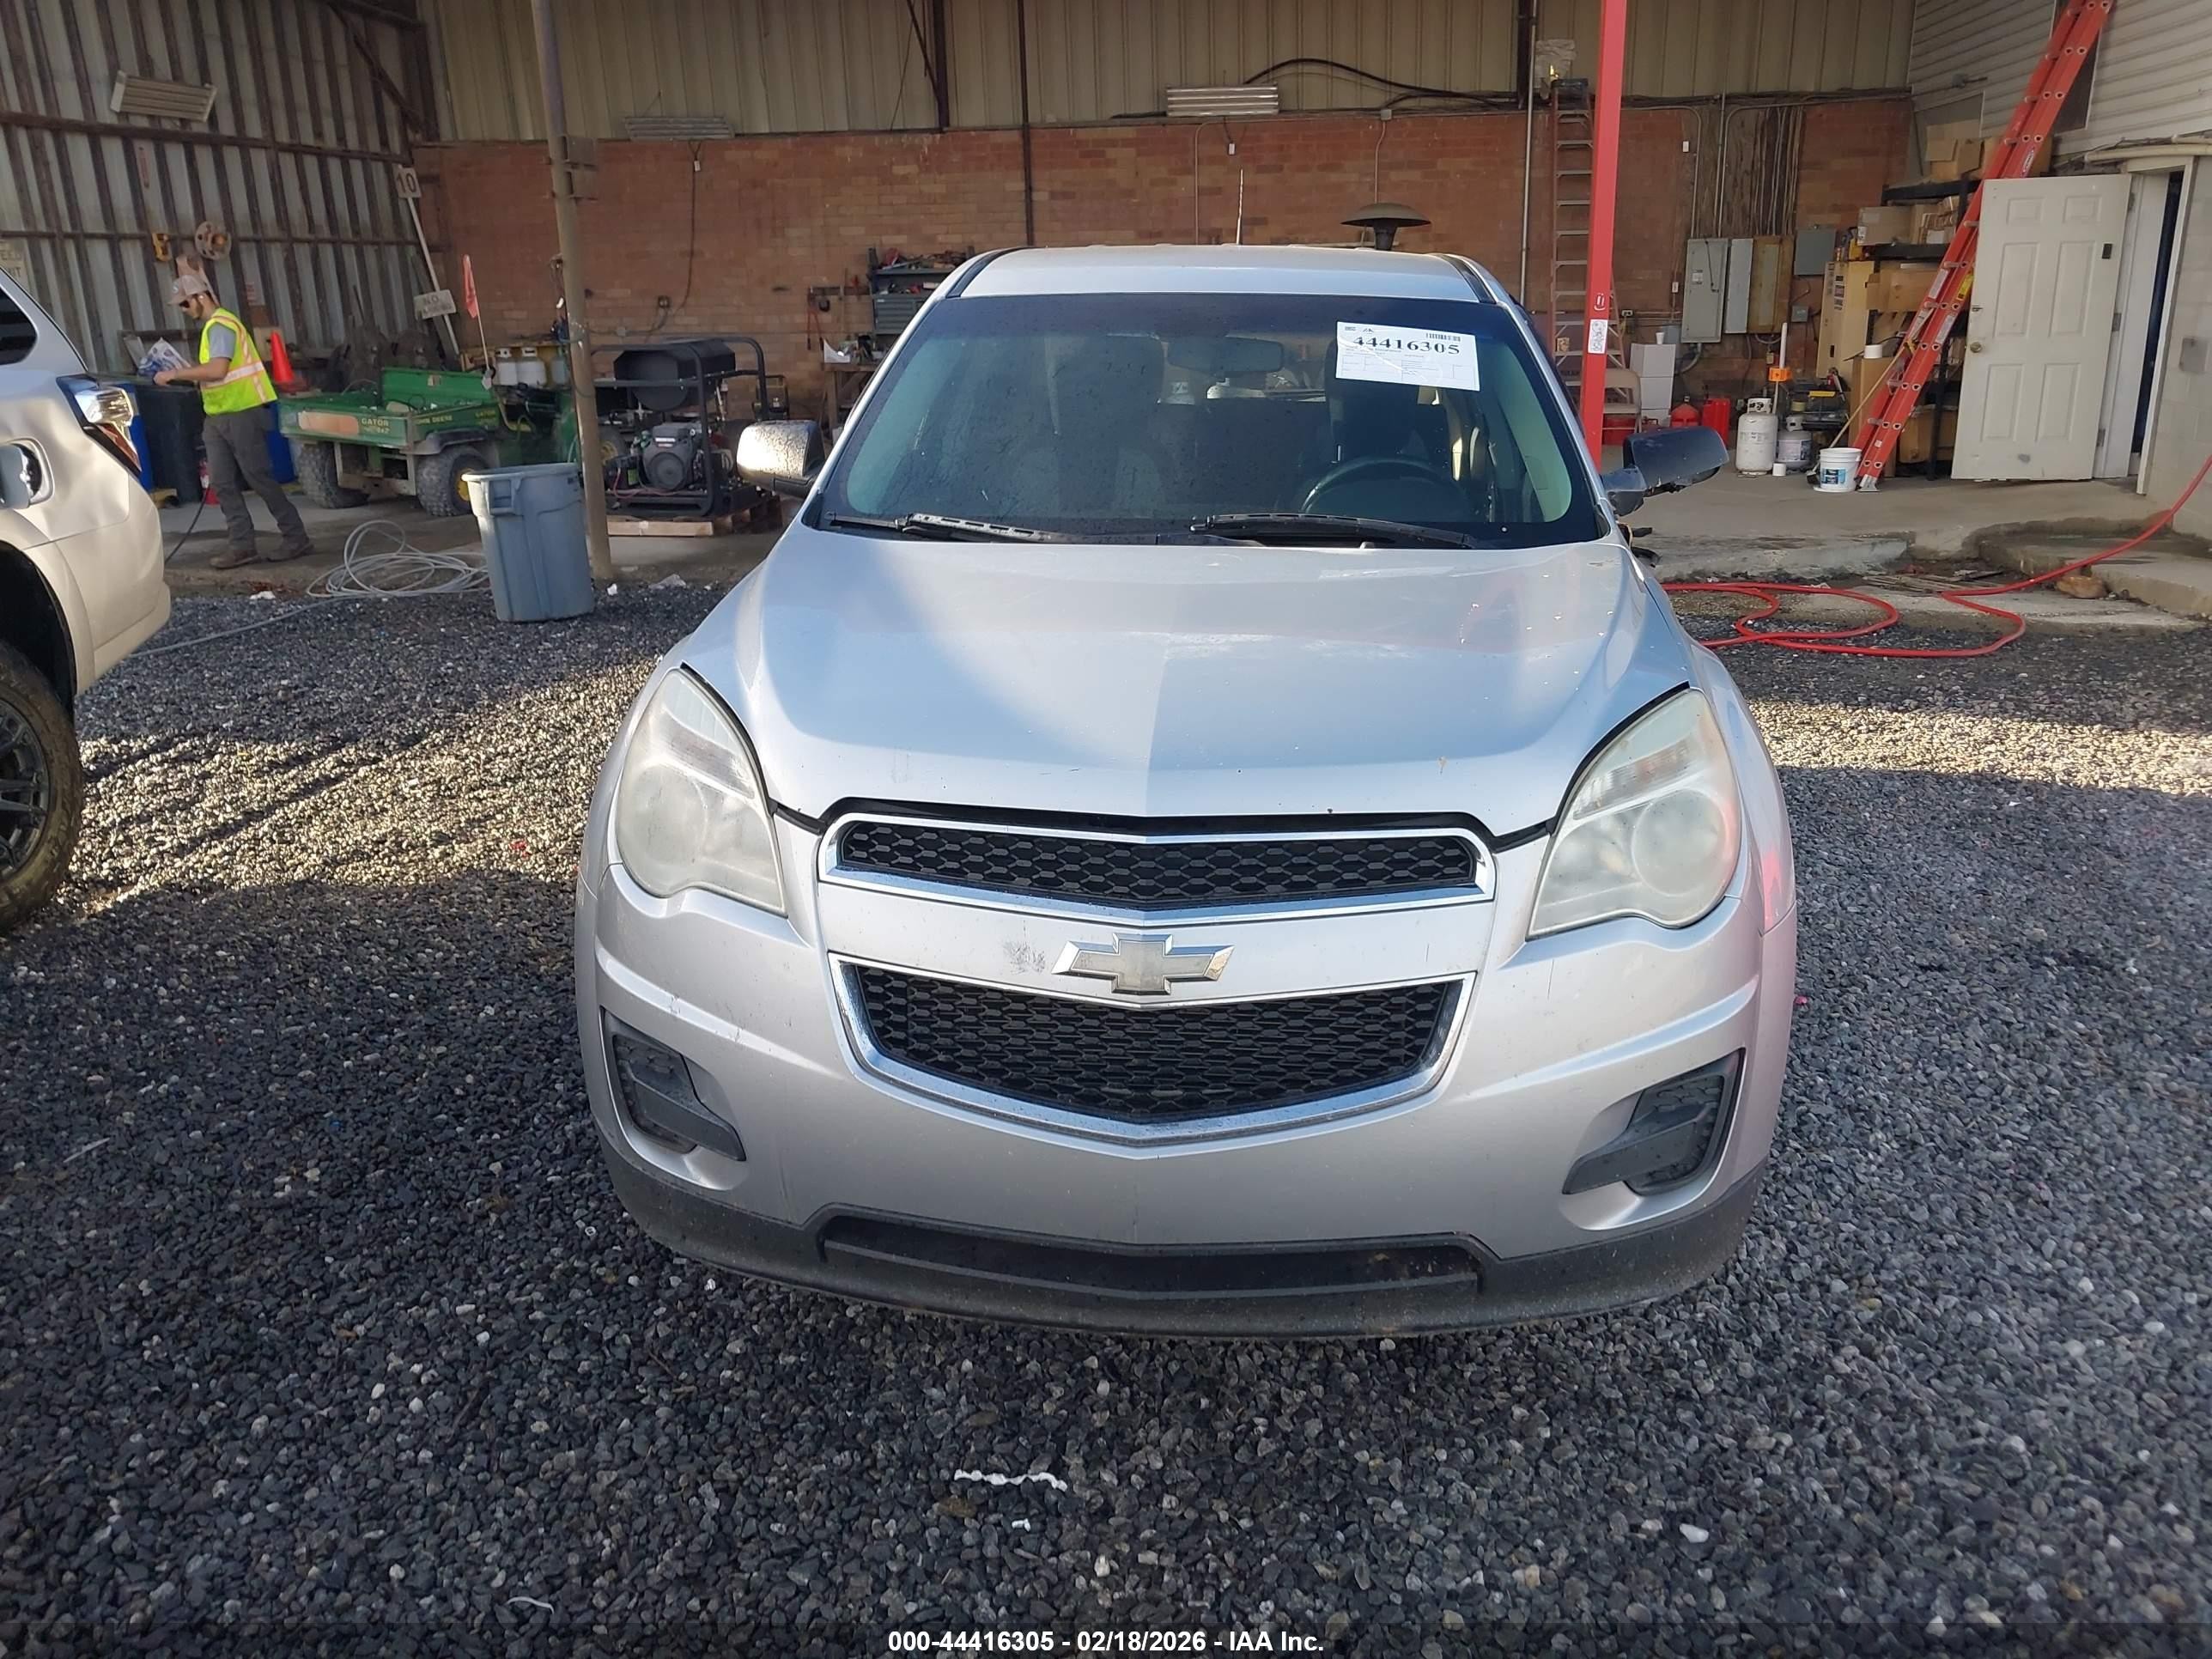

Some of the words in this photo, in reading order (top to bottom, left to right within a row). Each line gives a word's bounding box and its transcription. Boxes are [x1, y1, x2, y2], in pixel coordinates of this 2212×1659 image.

[398, 172, 416, 193] 10
[1352, 336, 1460, 355] 44416305
[362, 417, 389, 427] GATOR
